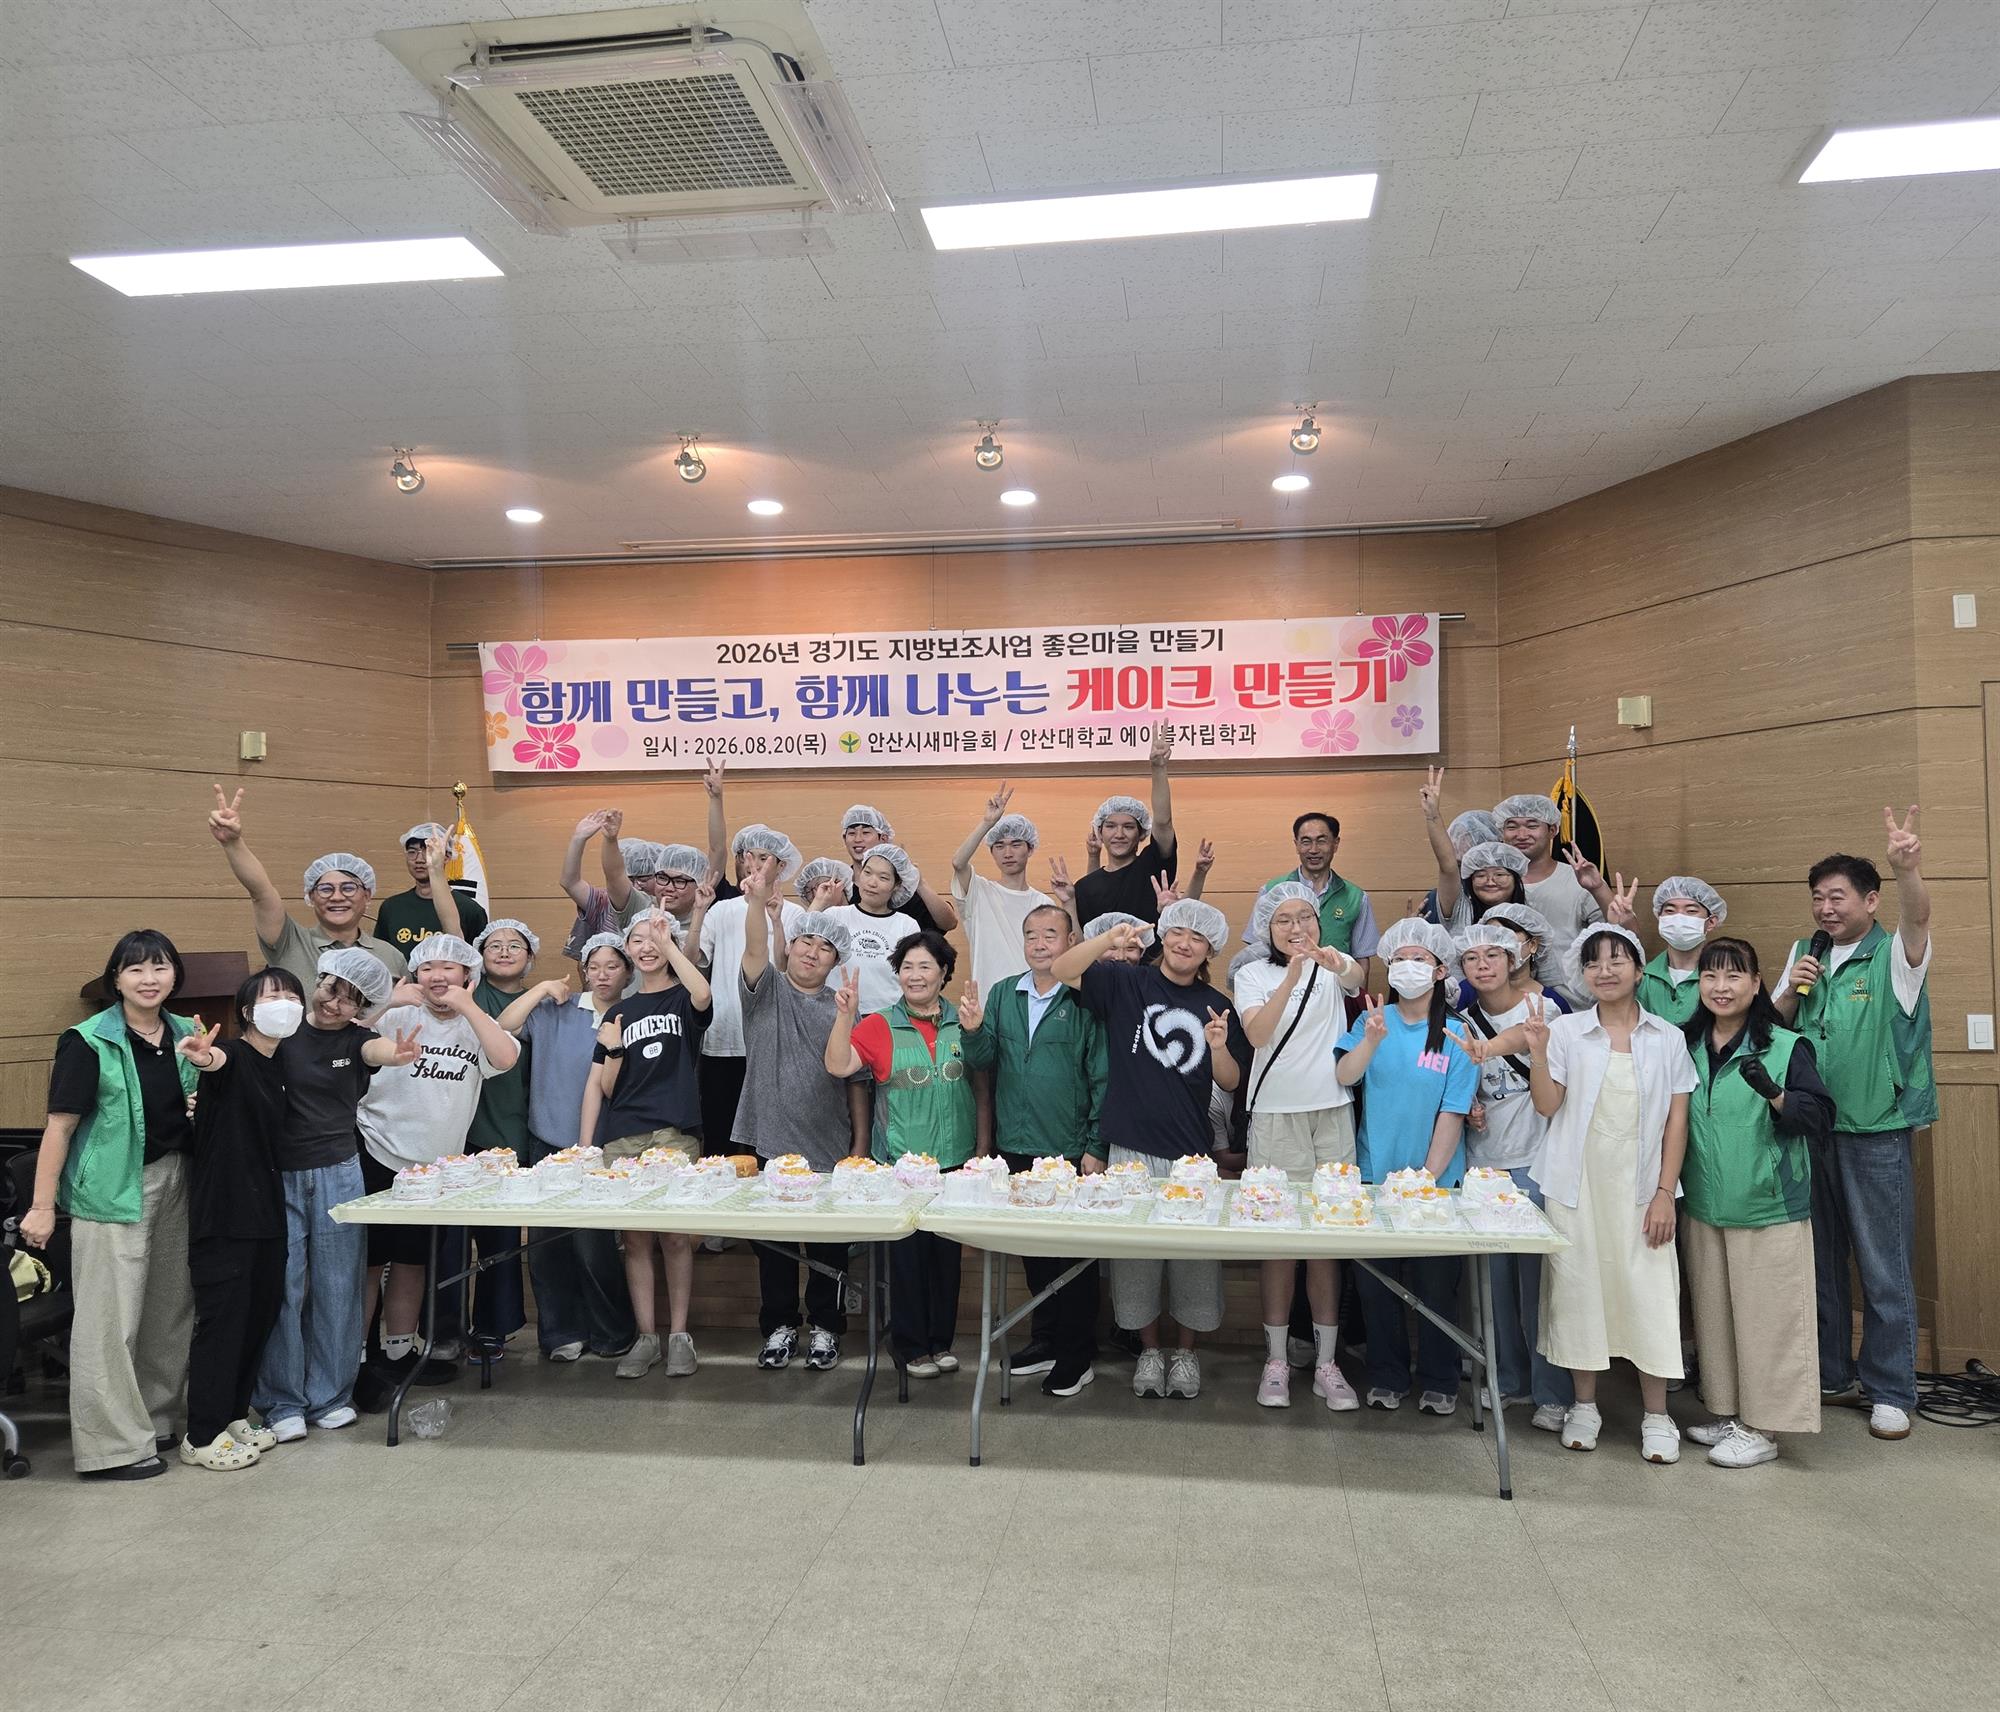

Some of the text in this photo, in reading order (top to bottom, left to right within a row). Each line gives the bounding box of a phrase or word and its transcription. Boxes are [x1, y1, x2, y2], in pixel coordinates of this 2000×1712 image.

[716, 627, 1224, 664] 2026년 경기도 지방보조사업 좋은마을 만들기
[521, 659, 1387, 725] 함께 만들고, 함께 나누는 케이크 만들기
[643, 735, 677, 758] 일시
[694, 732, 827, 757] 2026.08.20(목)
[867, 729, 997, 754] 안산시새마을회
[1003, 729, 1013, 752] /
[1020, 726, 1114, 750] 안산대학교
[409, 1057, 468, 1081] Island
